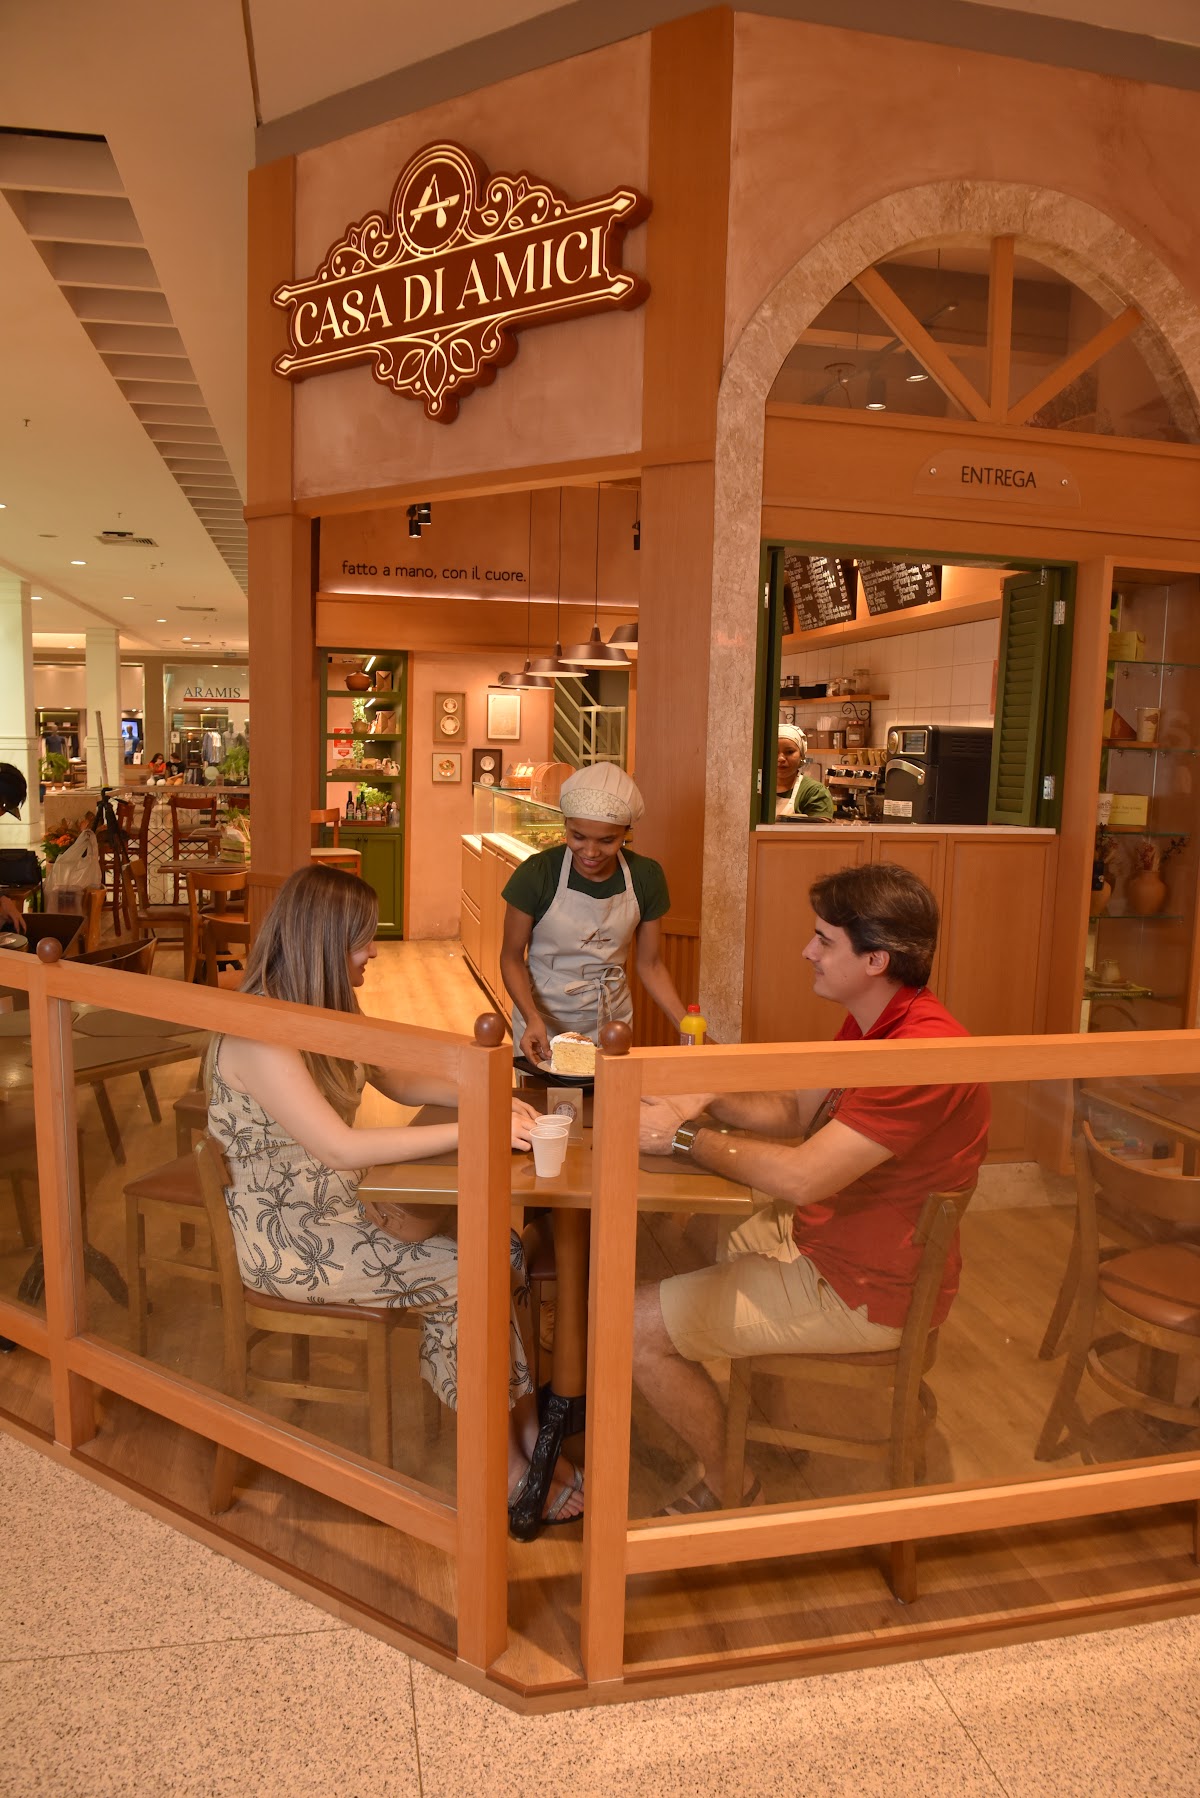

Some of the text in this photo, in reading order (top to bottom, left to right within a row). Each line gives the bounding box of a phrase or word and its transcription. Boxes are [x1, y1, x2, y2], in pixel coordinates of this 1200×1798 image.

[295, 225, 603, 347] CASA DI AMICI
[961, 465, 1037, 488] ENTREGA
[342, 560, 527, 582] fatto a mano, con il cuore.
[184, 686, 241, 698] ARAMIS
